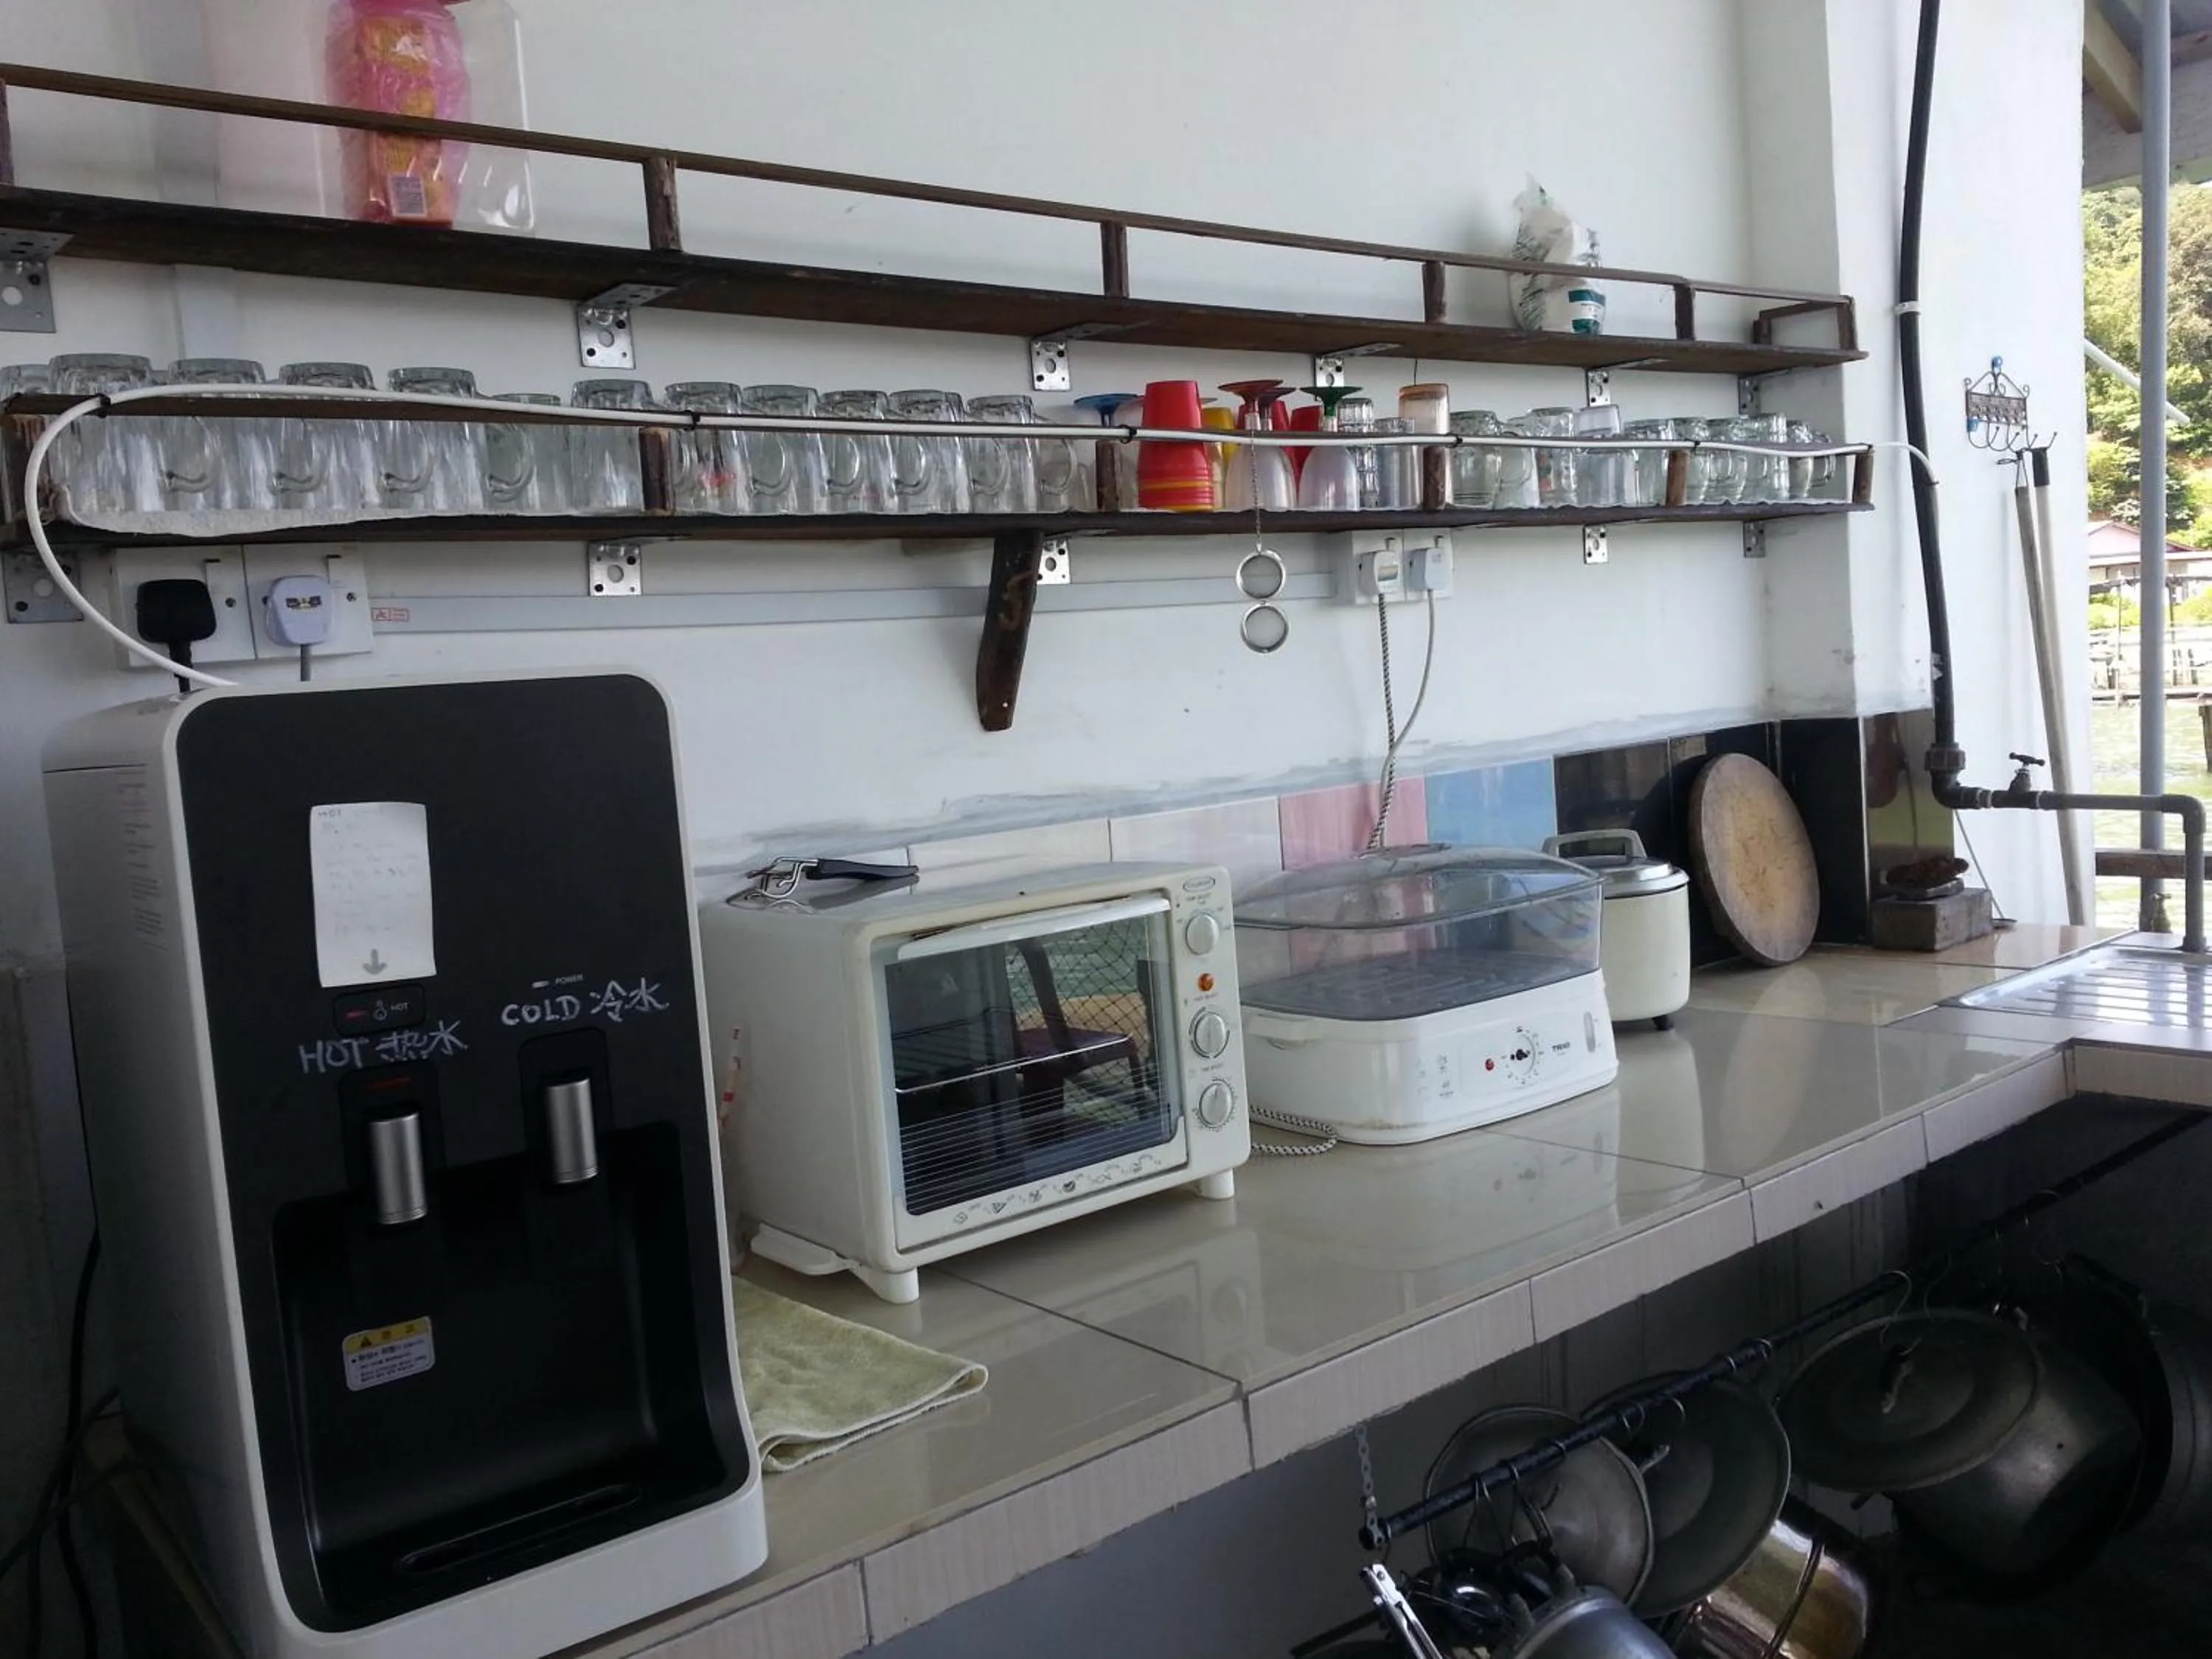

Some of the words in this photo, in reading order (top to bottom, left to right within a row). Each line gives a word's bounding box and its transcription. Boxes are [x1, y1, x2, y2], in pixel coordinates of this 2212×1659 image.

[555, 973, 583, 984] POWER
[391, 1003, 408, 1011] HOT
[501, 995, 580, 1026] COLD
[590, 977, 669, 1022] 冷水
[298, 1037, 369, 1074] HOT
